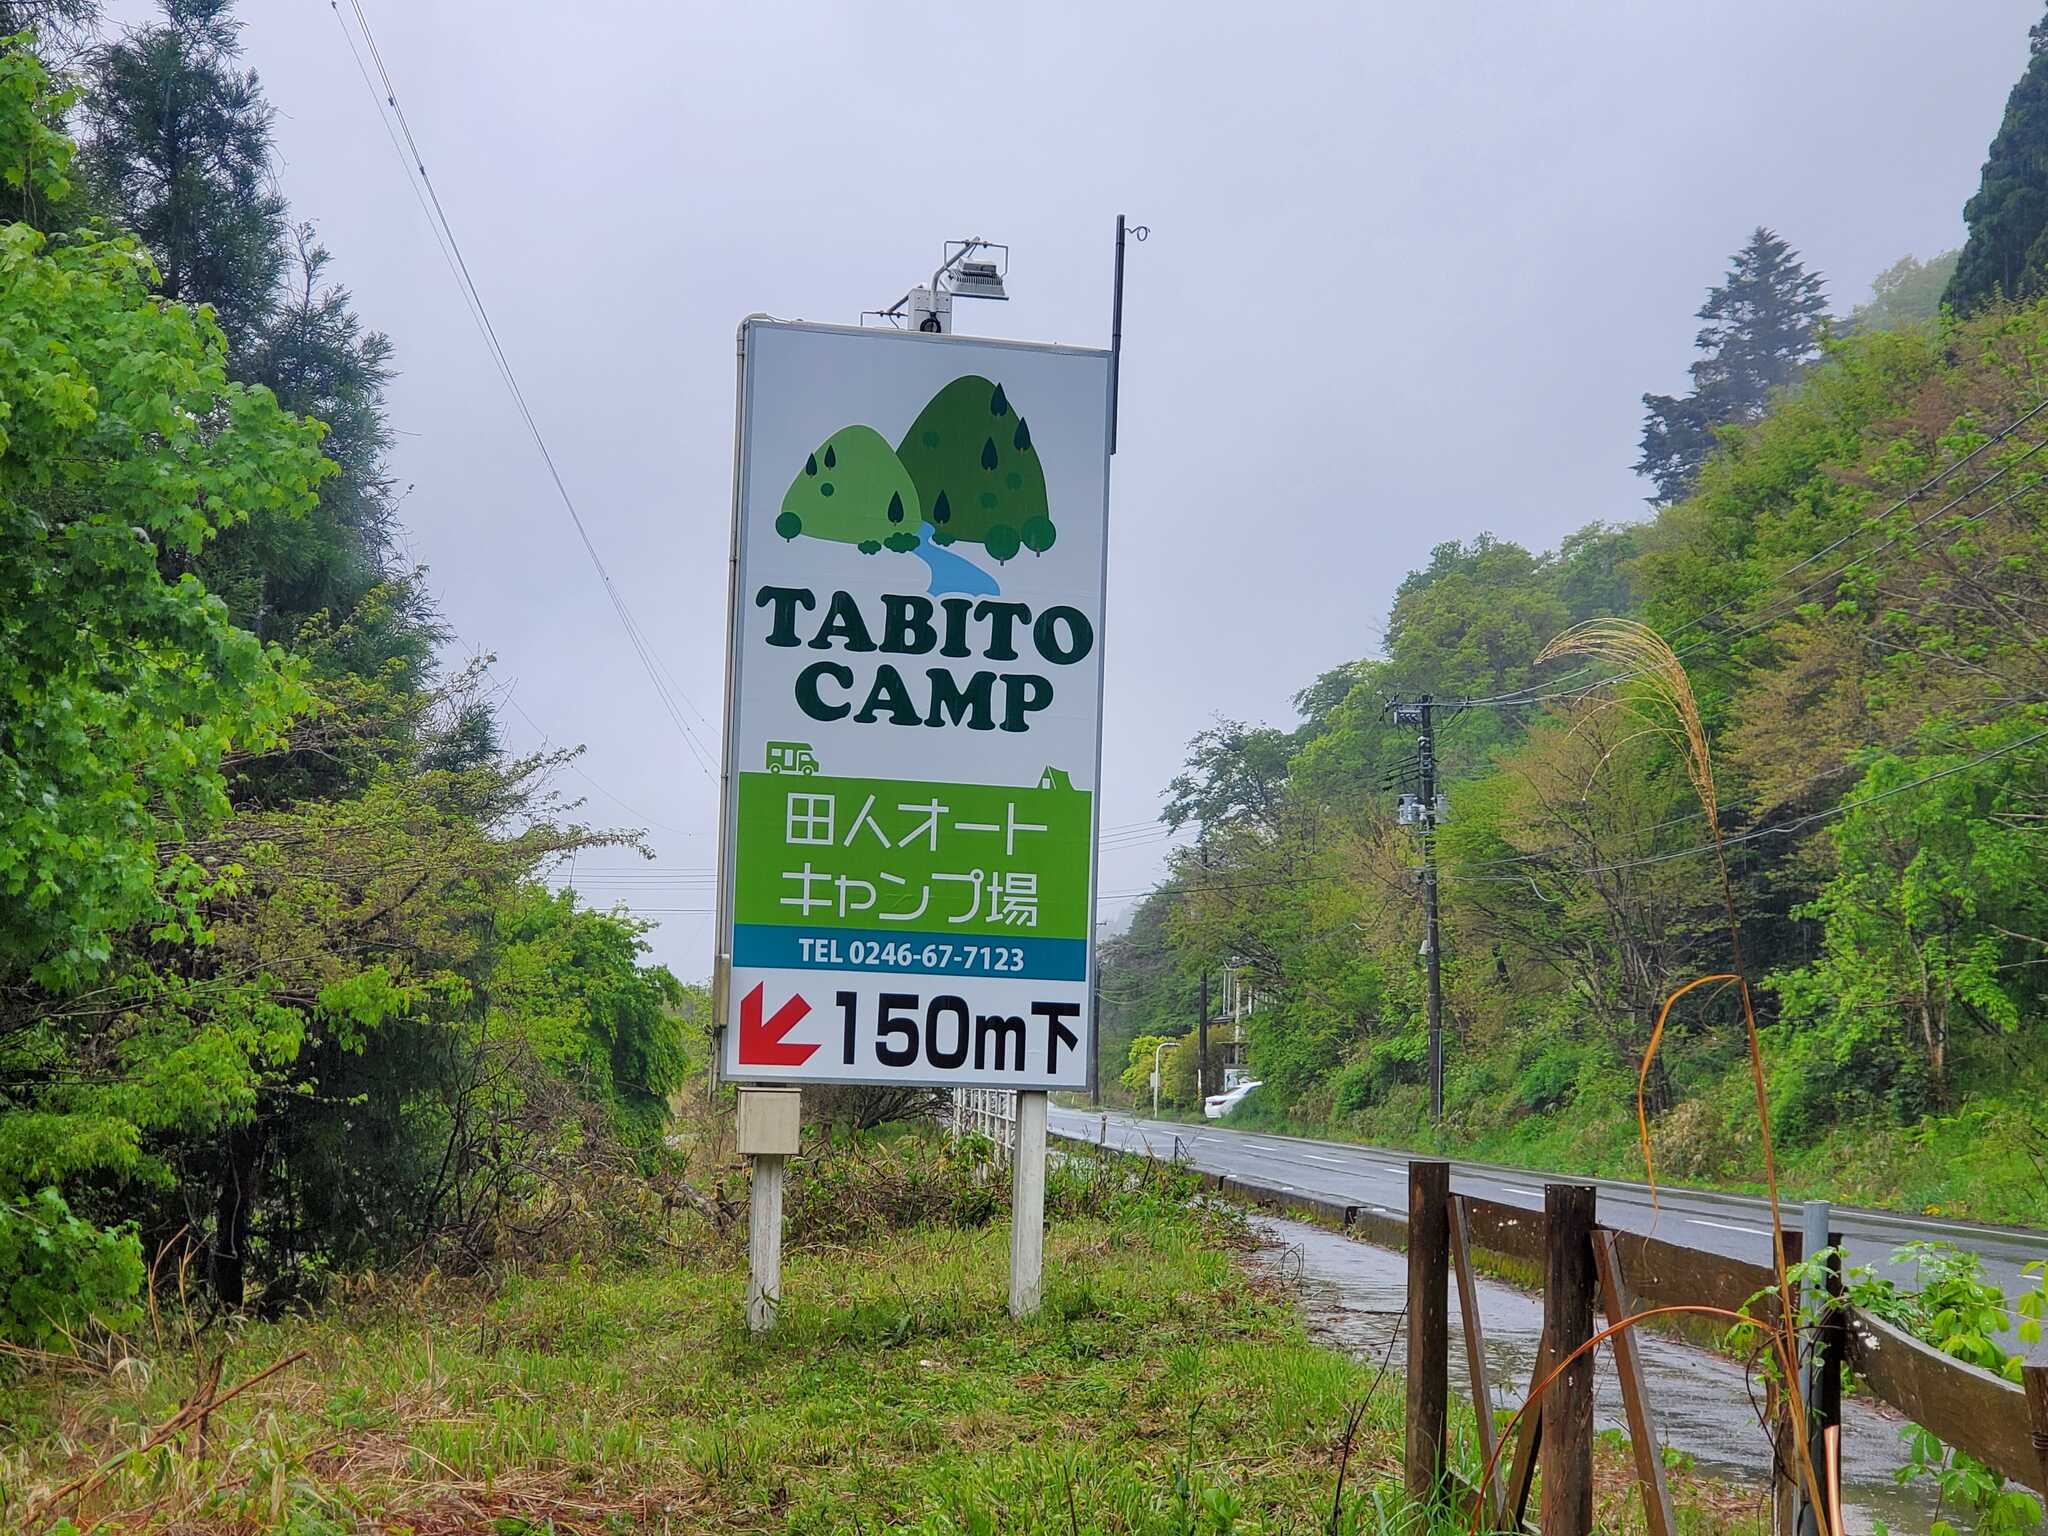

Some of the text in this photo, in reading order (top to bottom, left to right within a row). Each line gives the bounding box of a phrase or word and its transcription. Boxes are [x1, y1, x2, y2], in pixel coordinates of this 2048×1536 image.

[756, 585, 1094, 665] TABITO
[795, 661, 1054, 732] CAMP
[785, 792, 1048, 856] 田人オート
[780, 862, 1039, 927] キャンプ場
[799, 938, 1025, 971] TEL 0246-67-7123
